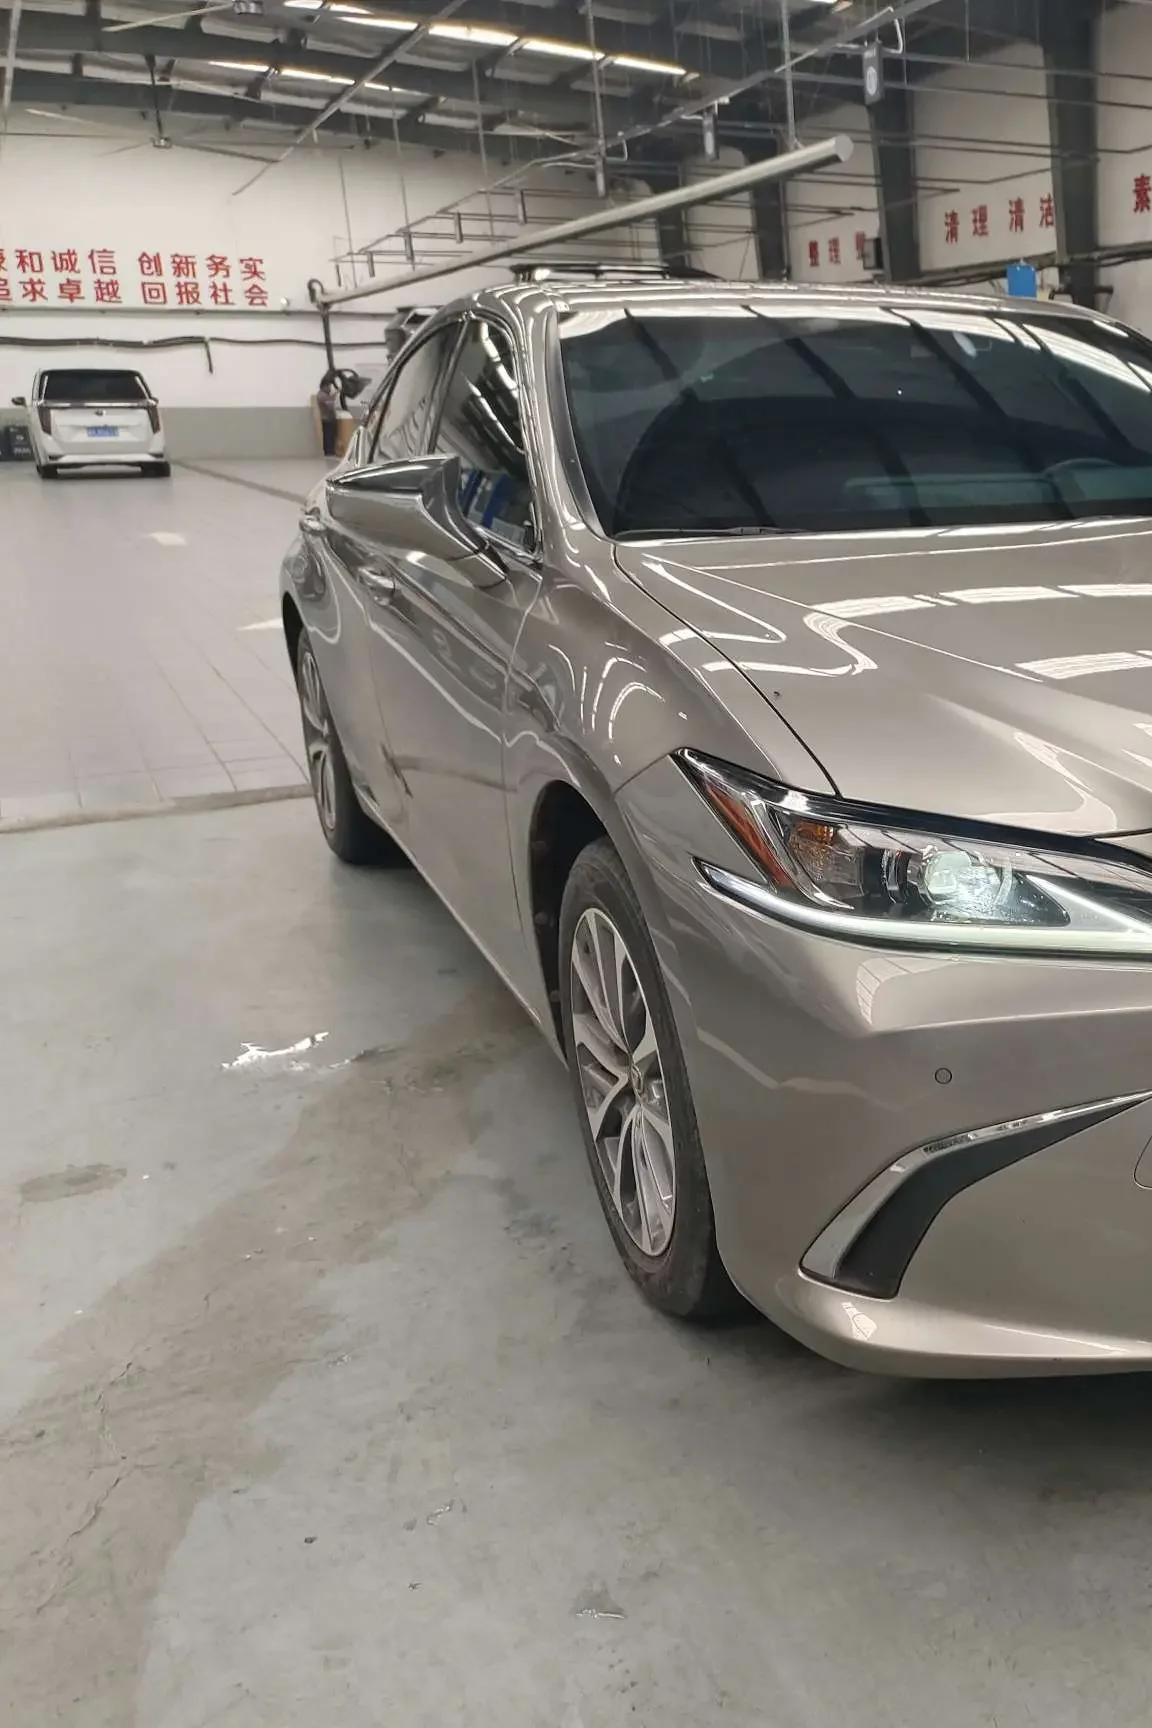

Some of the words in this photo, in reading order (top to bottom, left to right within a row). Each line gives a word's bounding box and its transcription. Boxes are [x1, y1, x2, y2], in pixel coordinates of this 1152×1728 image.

[137, 252, 266, 281] 创新务实
[141, 281, 268, 307] 回报社会
